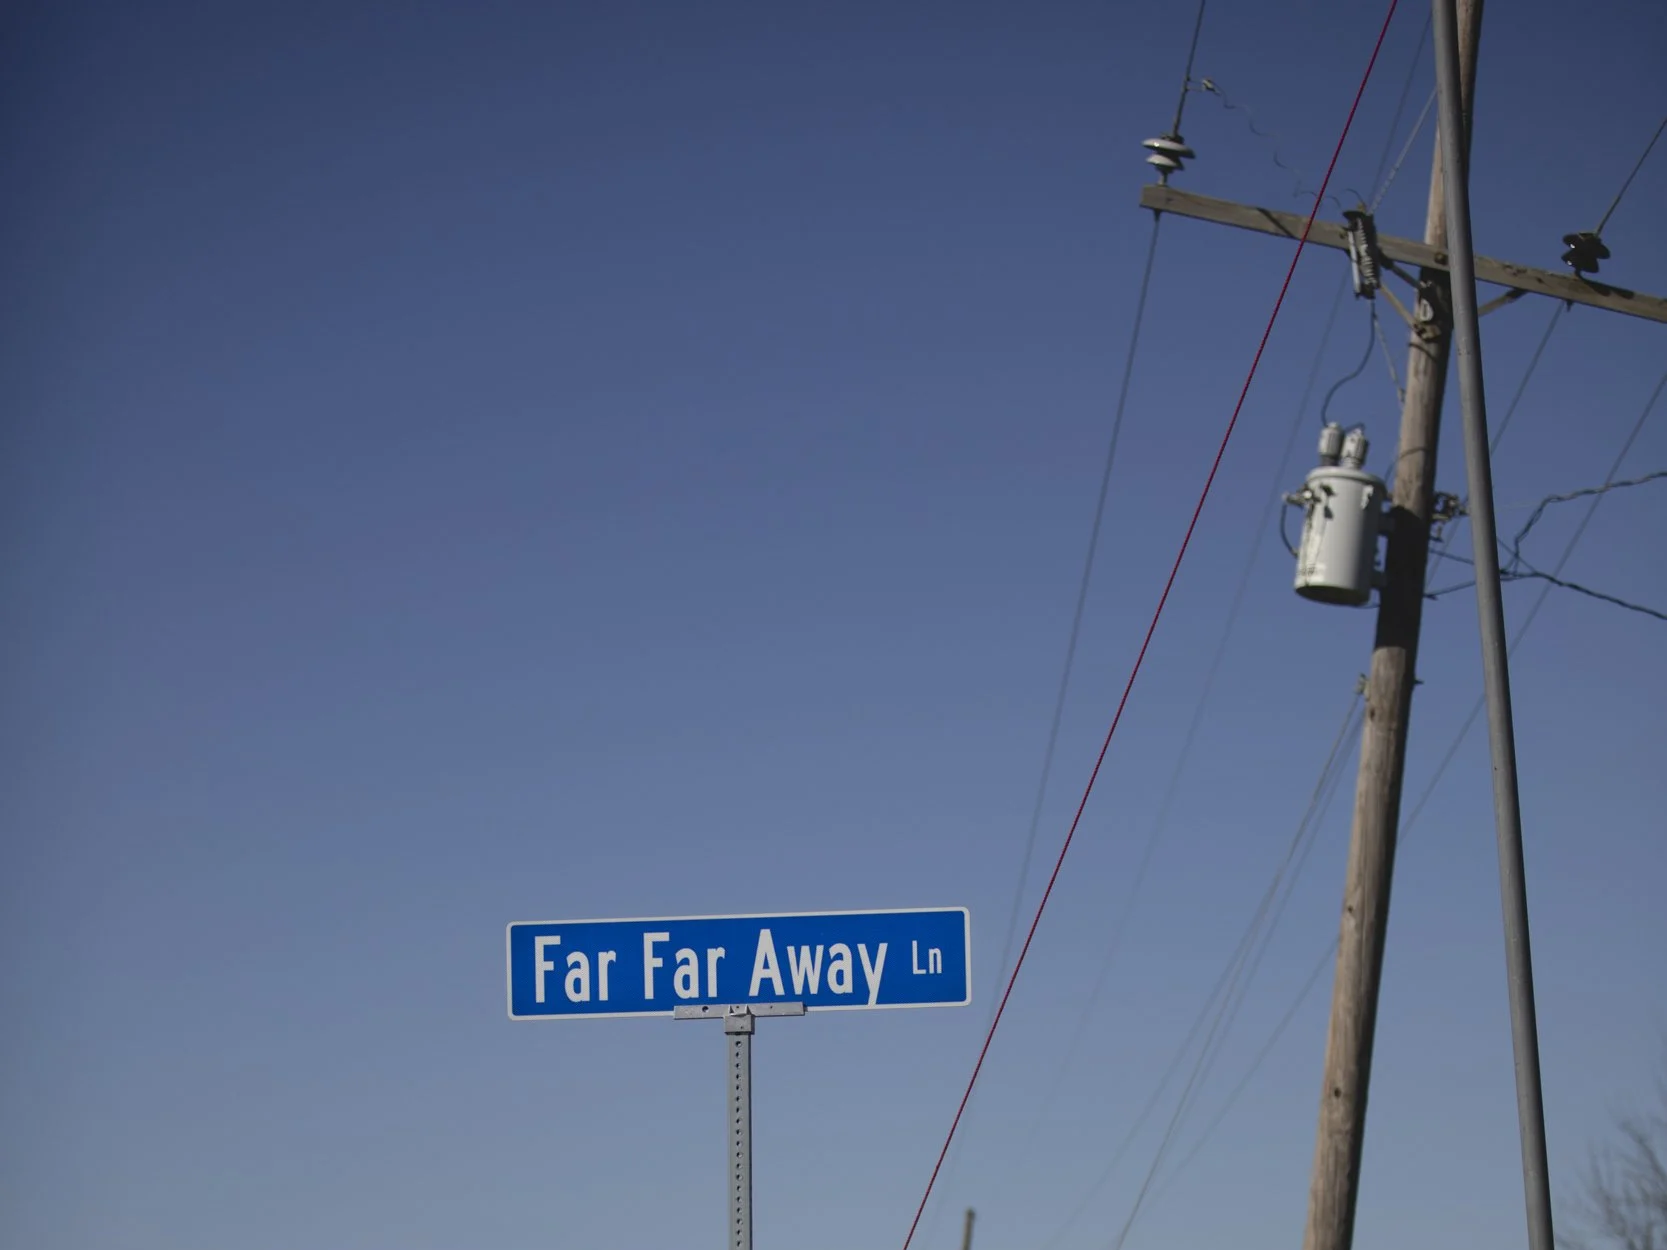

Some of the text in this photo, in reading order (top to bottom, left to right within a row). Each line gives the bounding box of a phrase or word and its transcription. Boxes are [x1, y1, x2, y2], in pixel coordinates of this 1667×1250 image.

[534, 928, 943, 1006] Far Far Away Ln
